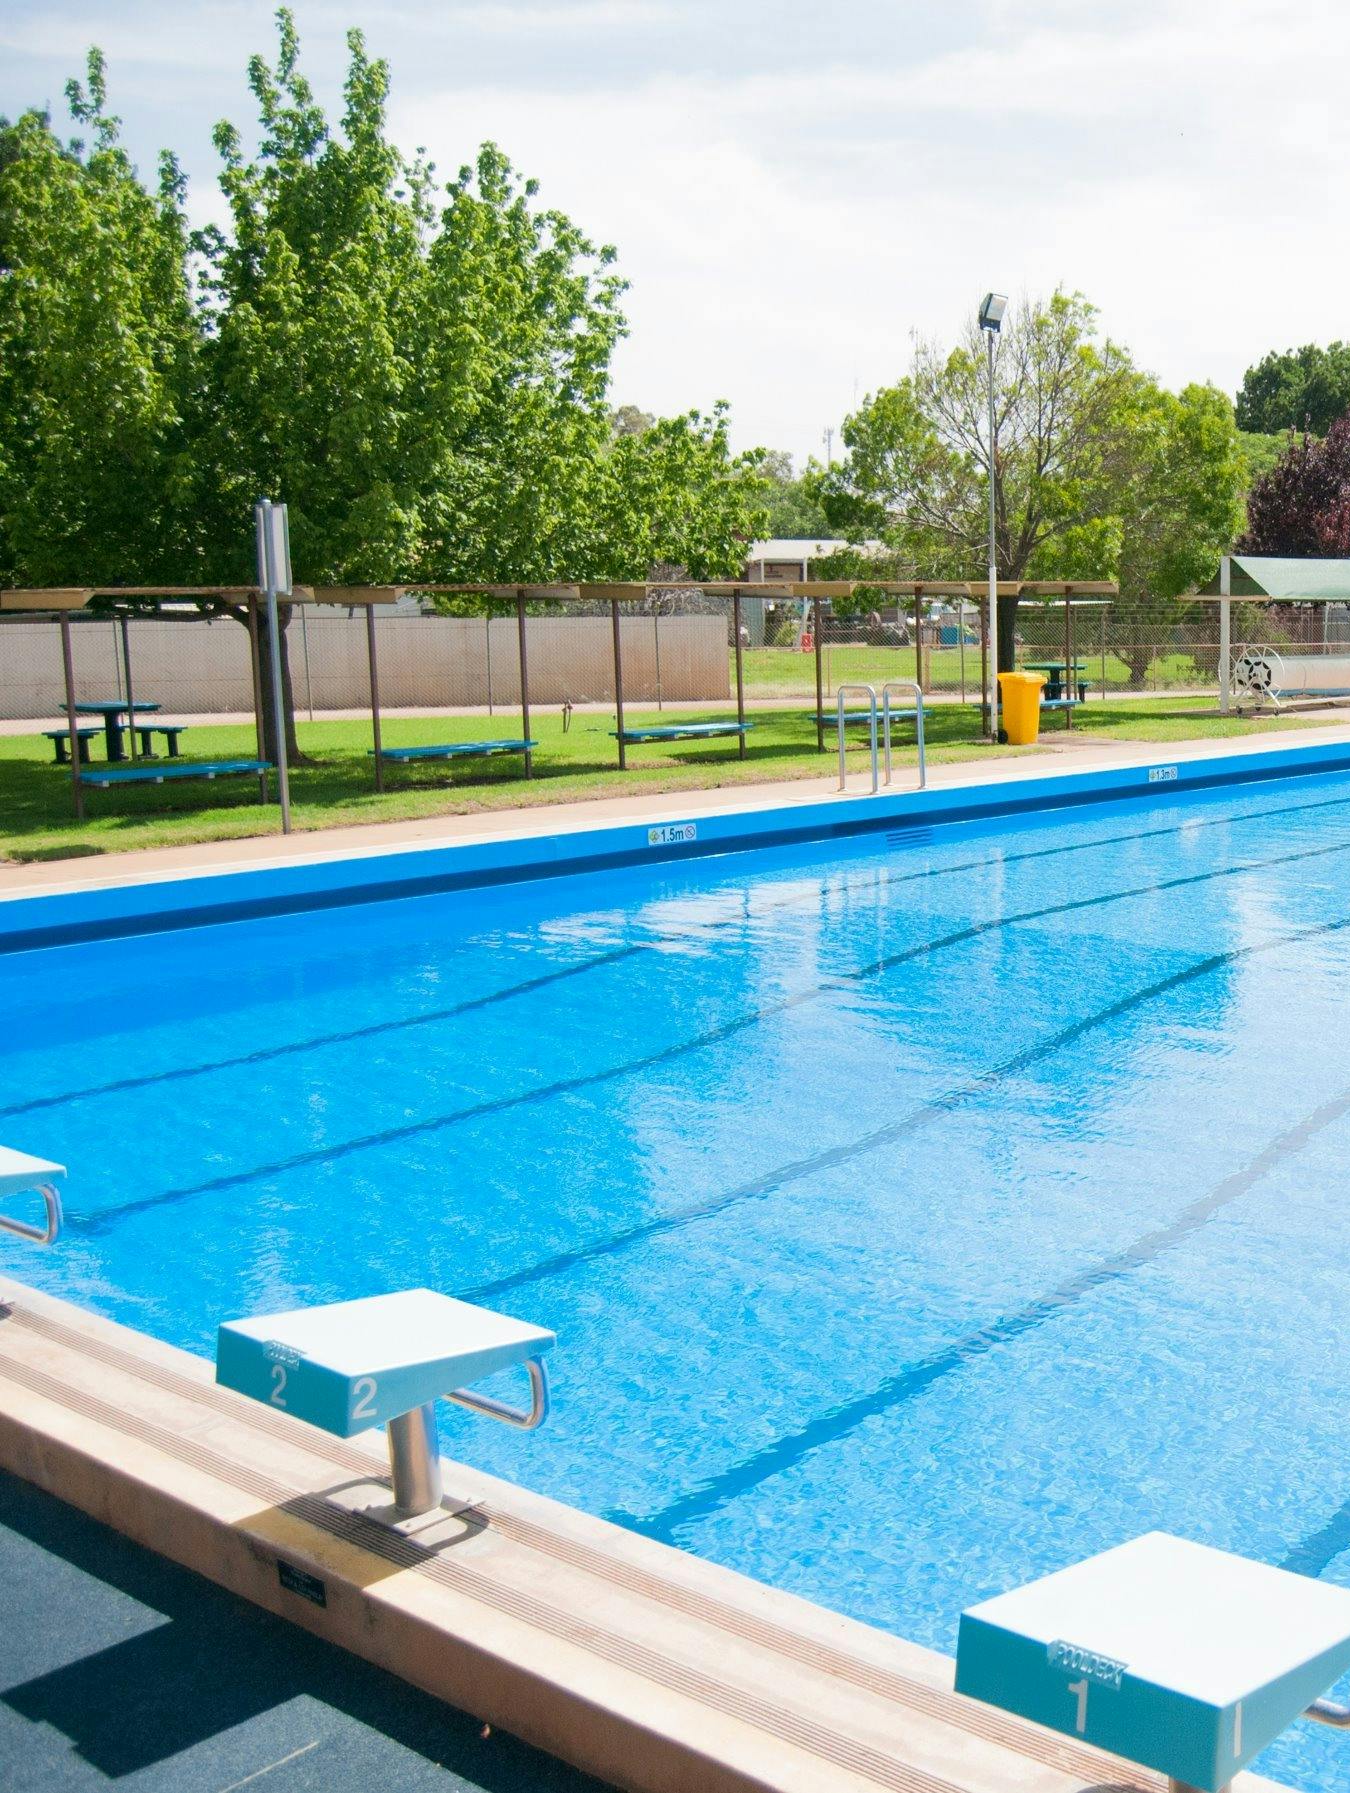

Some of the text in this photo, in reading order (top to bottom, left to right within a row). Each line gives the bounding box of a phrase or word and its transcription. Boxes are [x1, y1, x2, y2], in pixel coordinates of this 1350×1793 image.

[1156, 769, 1170, 780] 1.3m
[661, 828, 684, 842] 1.5m
[271, 1364, 287, 1407] 2
[352, 1377, 378, 1419] 2
[1067, 1679, 1088, 1733] 1
